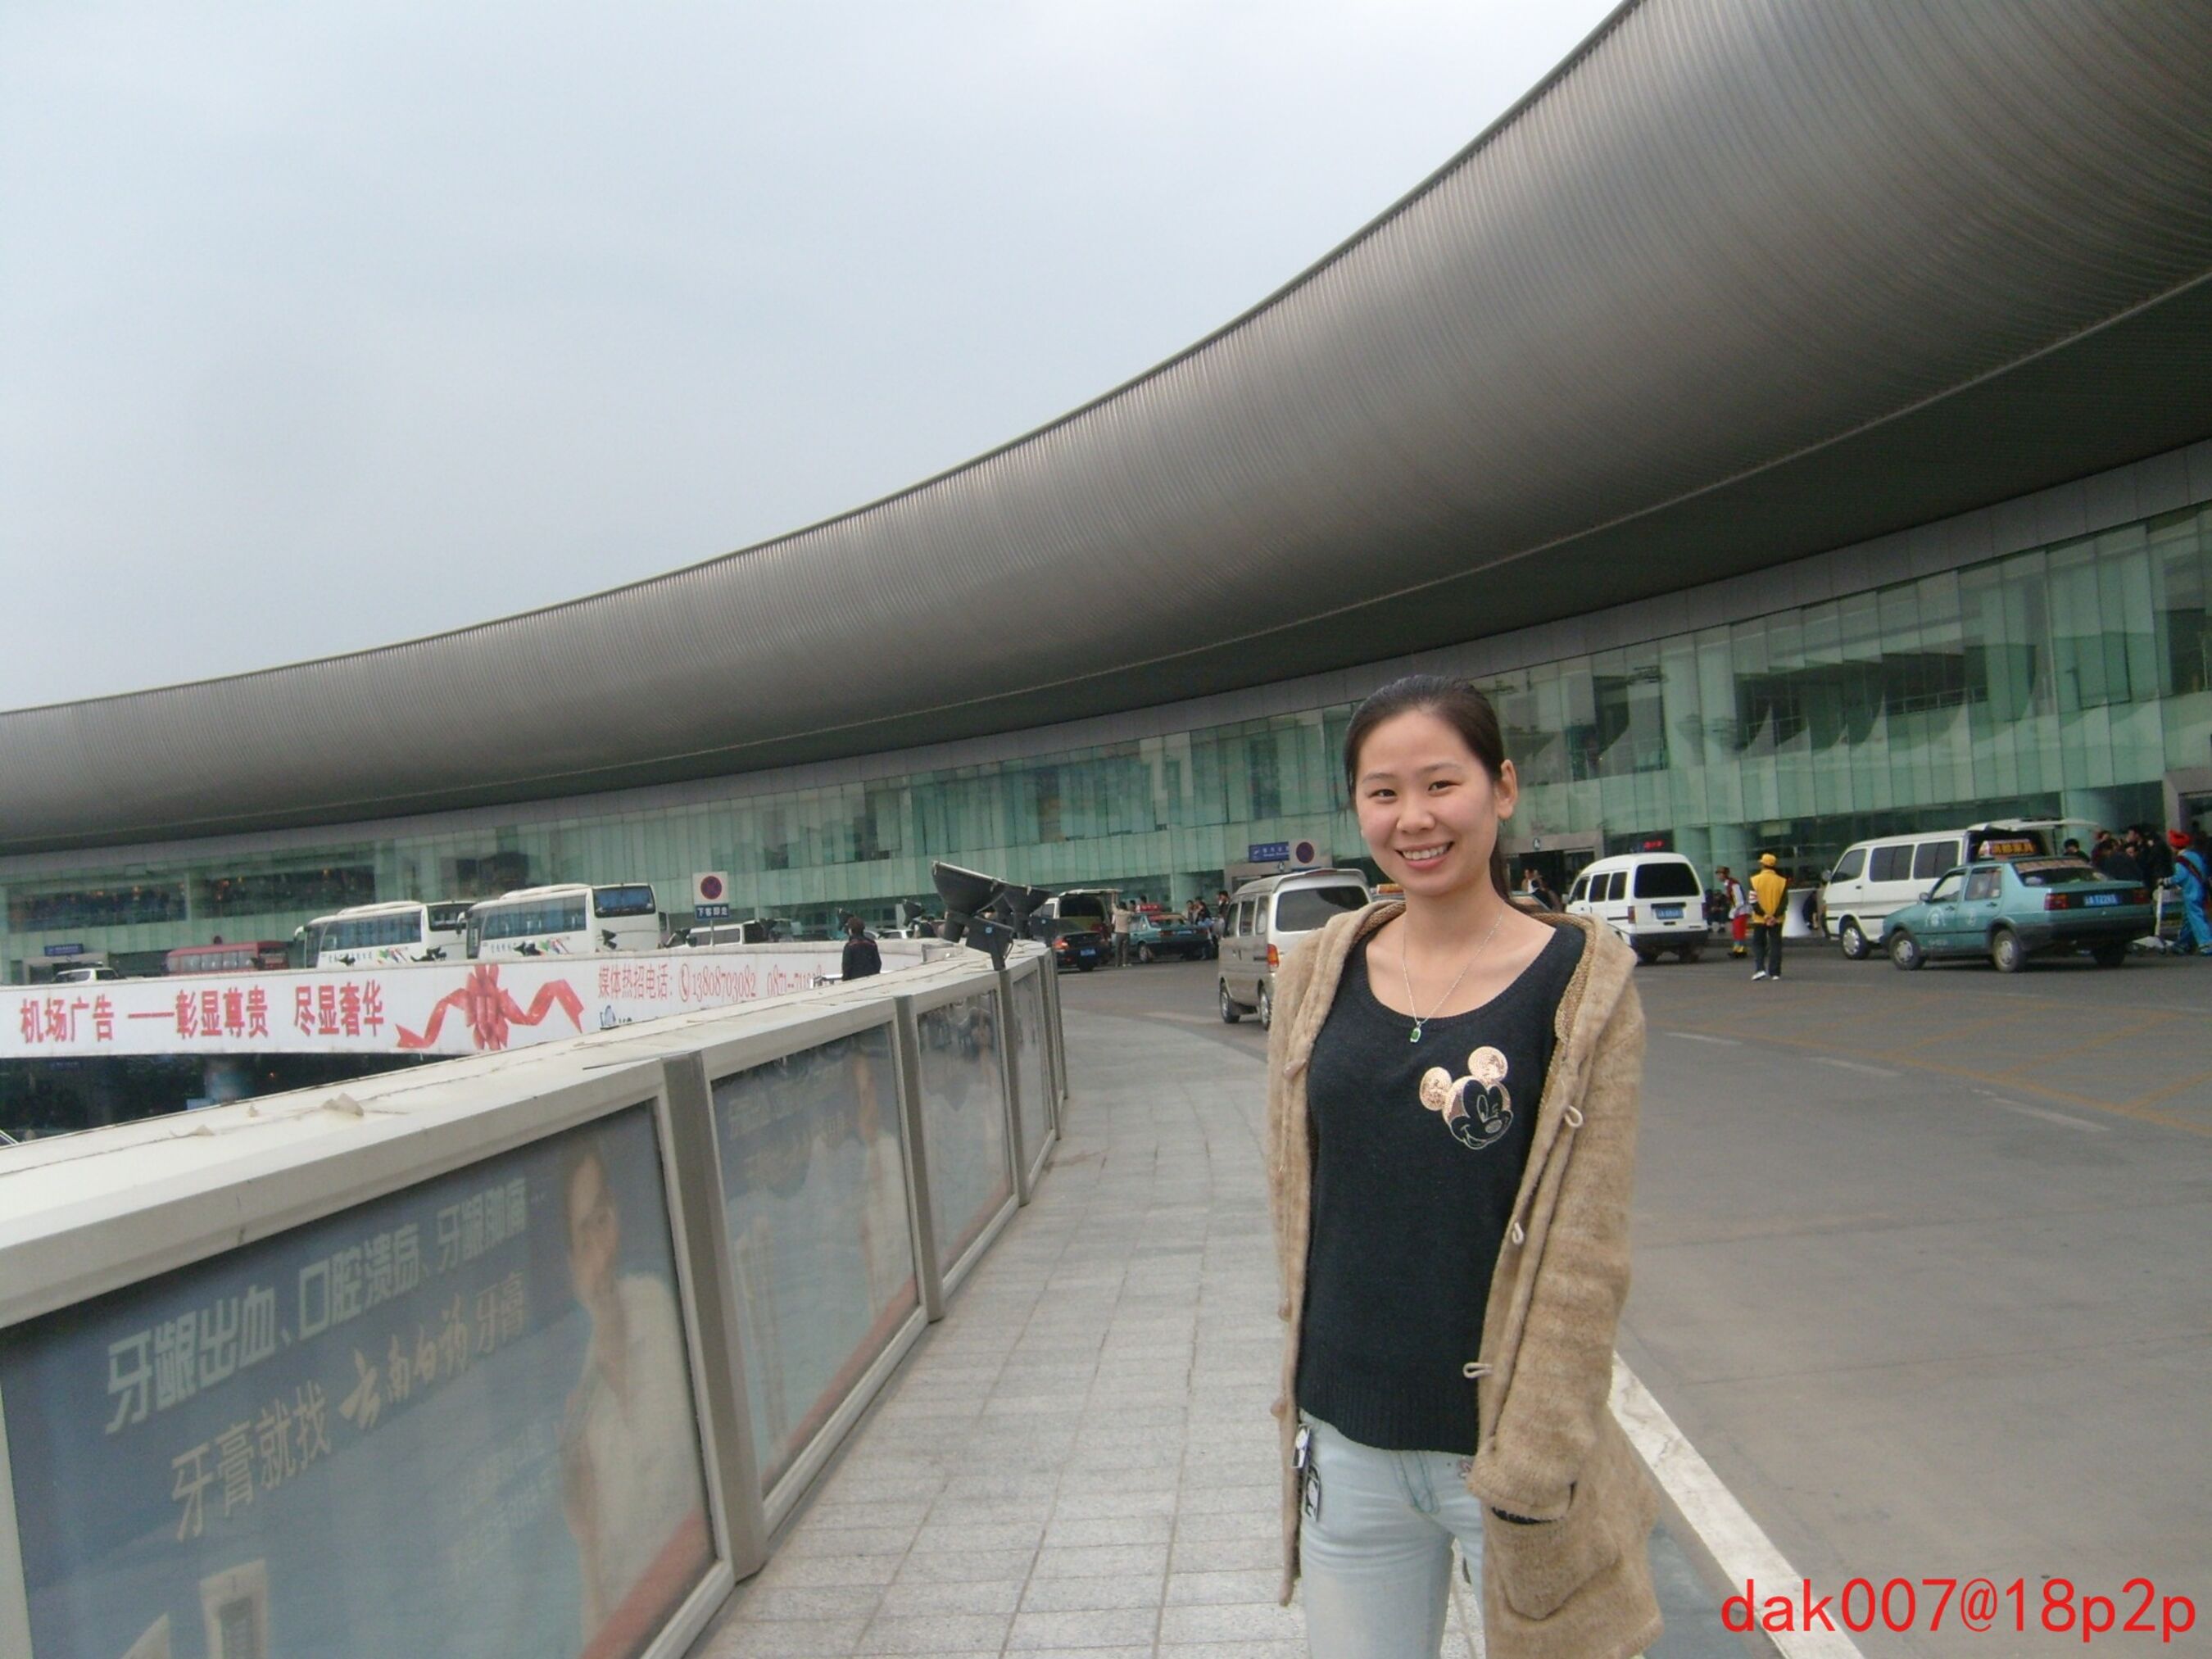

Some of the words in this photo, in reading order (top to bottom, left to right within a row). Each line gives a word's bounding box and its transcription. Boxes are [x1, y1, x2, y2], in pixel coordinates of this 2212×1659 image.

[20, 995, 114, 1043] 机场广告
[294, 980, 384, 1037] 尽显奢华
